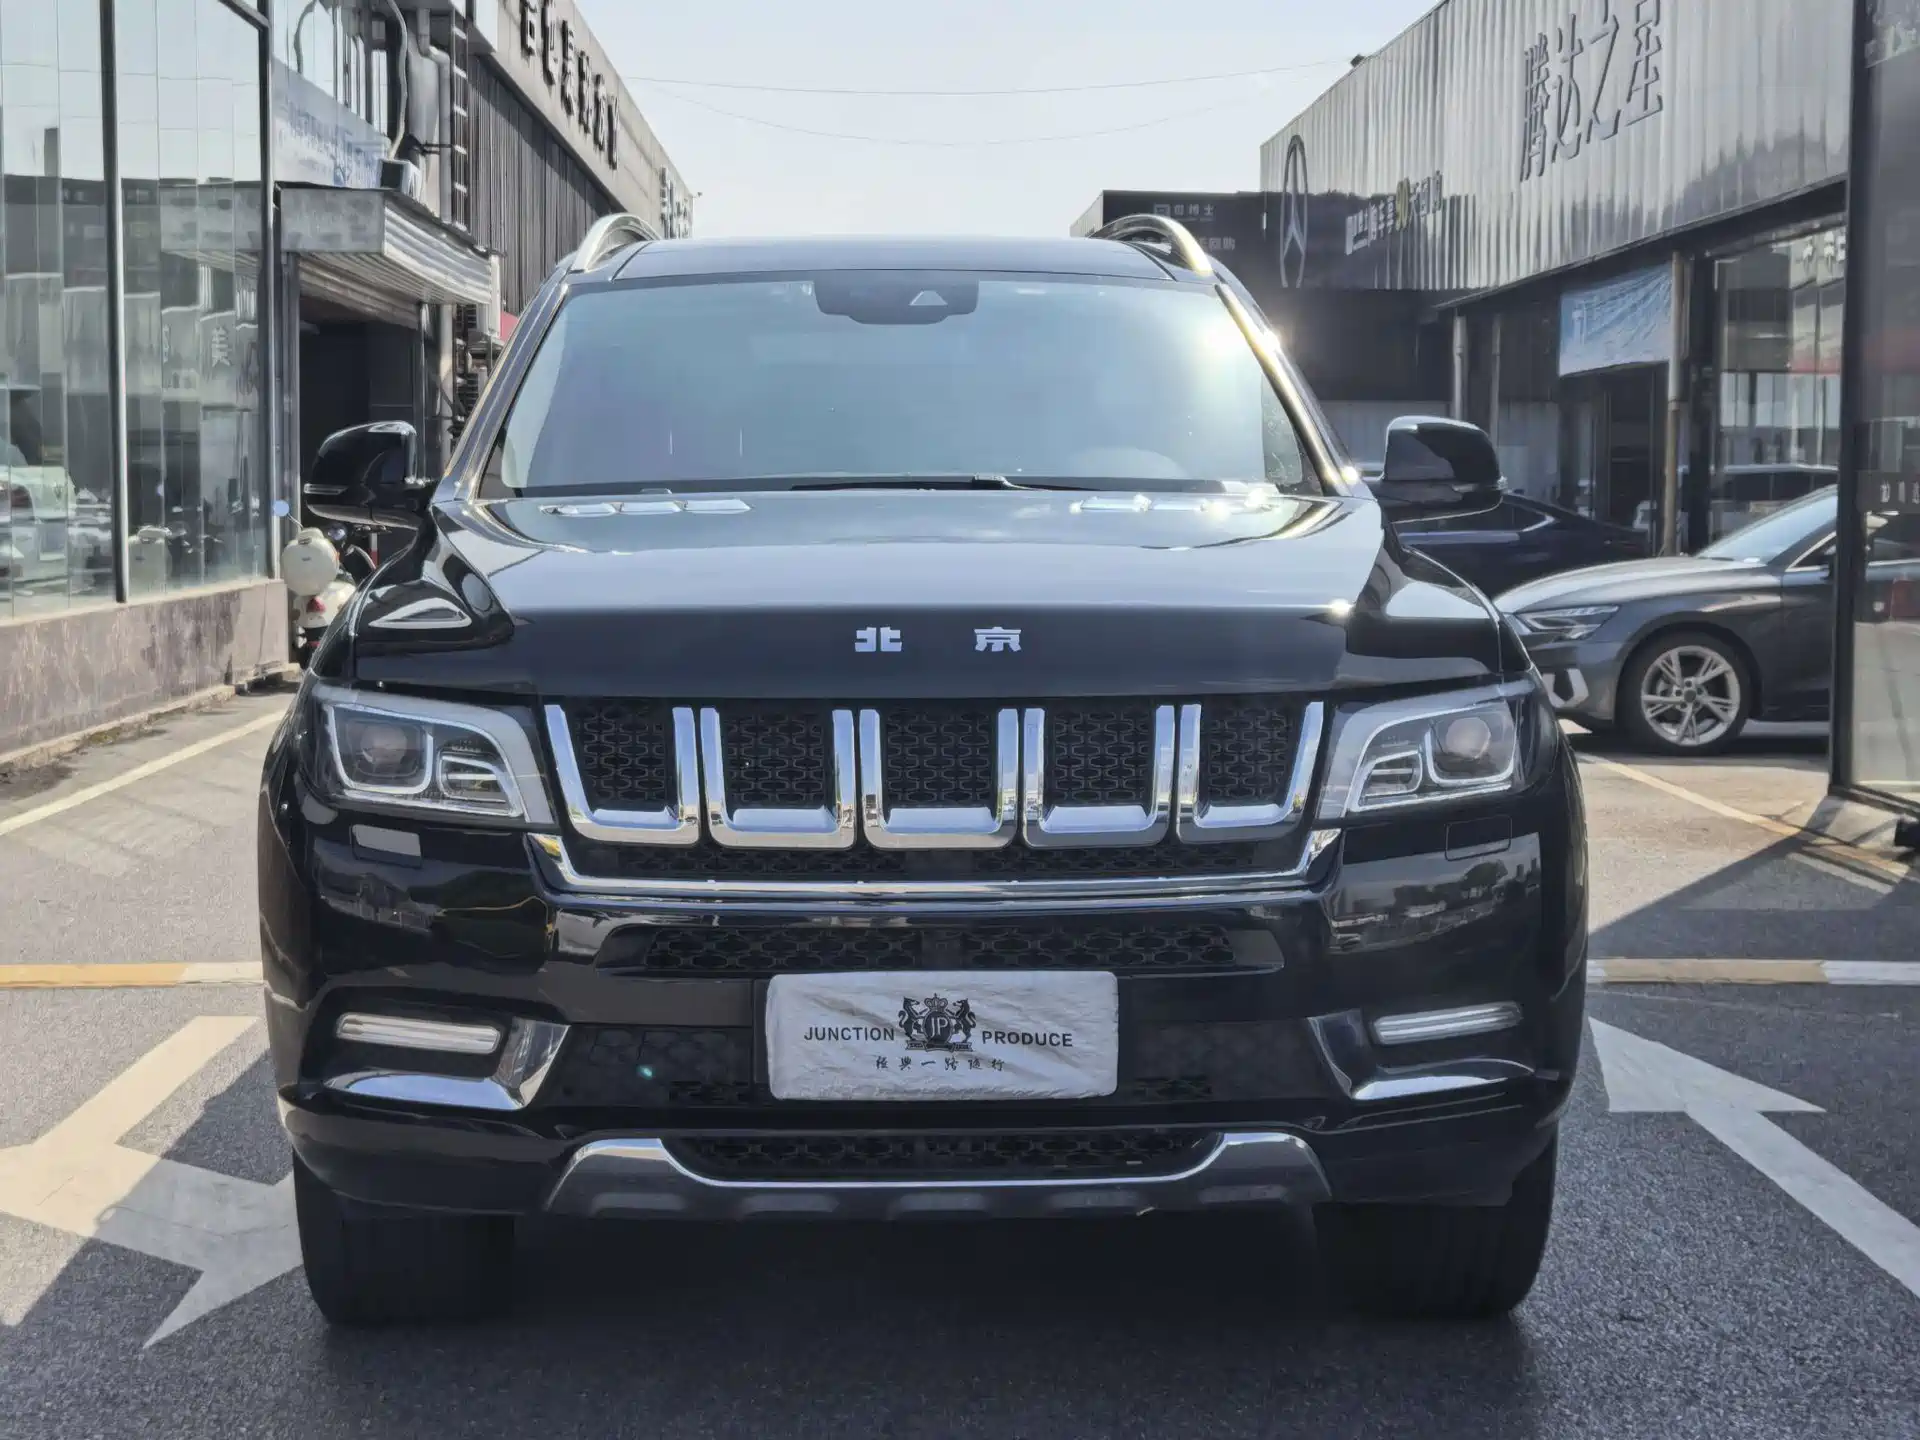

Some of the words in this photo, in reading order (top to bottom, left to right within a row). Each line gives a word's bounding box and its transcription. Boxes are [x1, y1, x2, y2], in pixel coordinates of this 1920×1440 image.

[1519, 0, 1663, 183] 腾达之星
[855, 626, 1022, 652] 北京
[803, 1026, 895, 1042] JUNCTION
[982, 1030, 1073, 1047] PRODUCE
